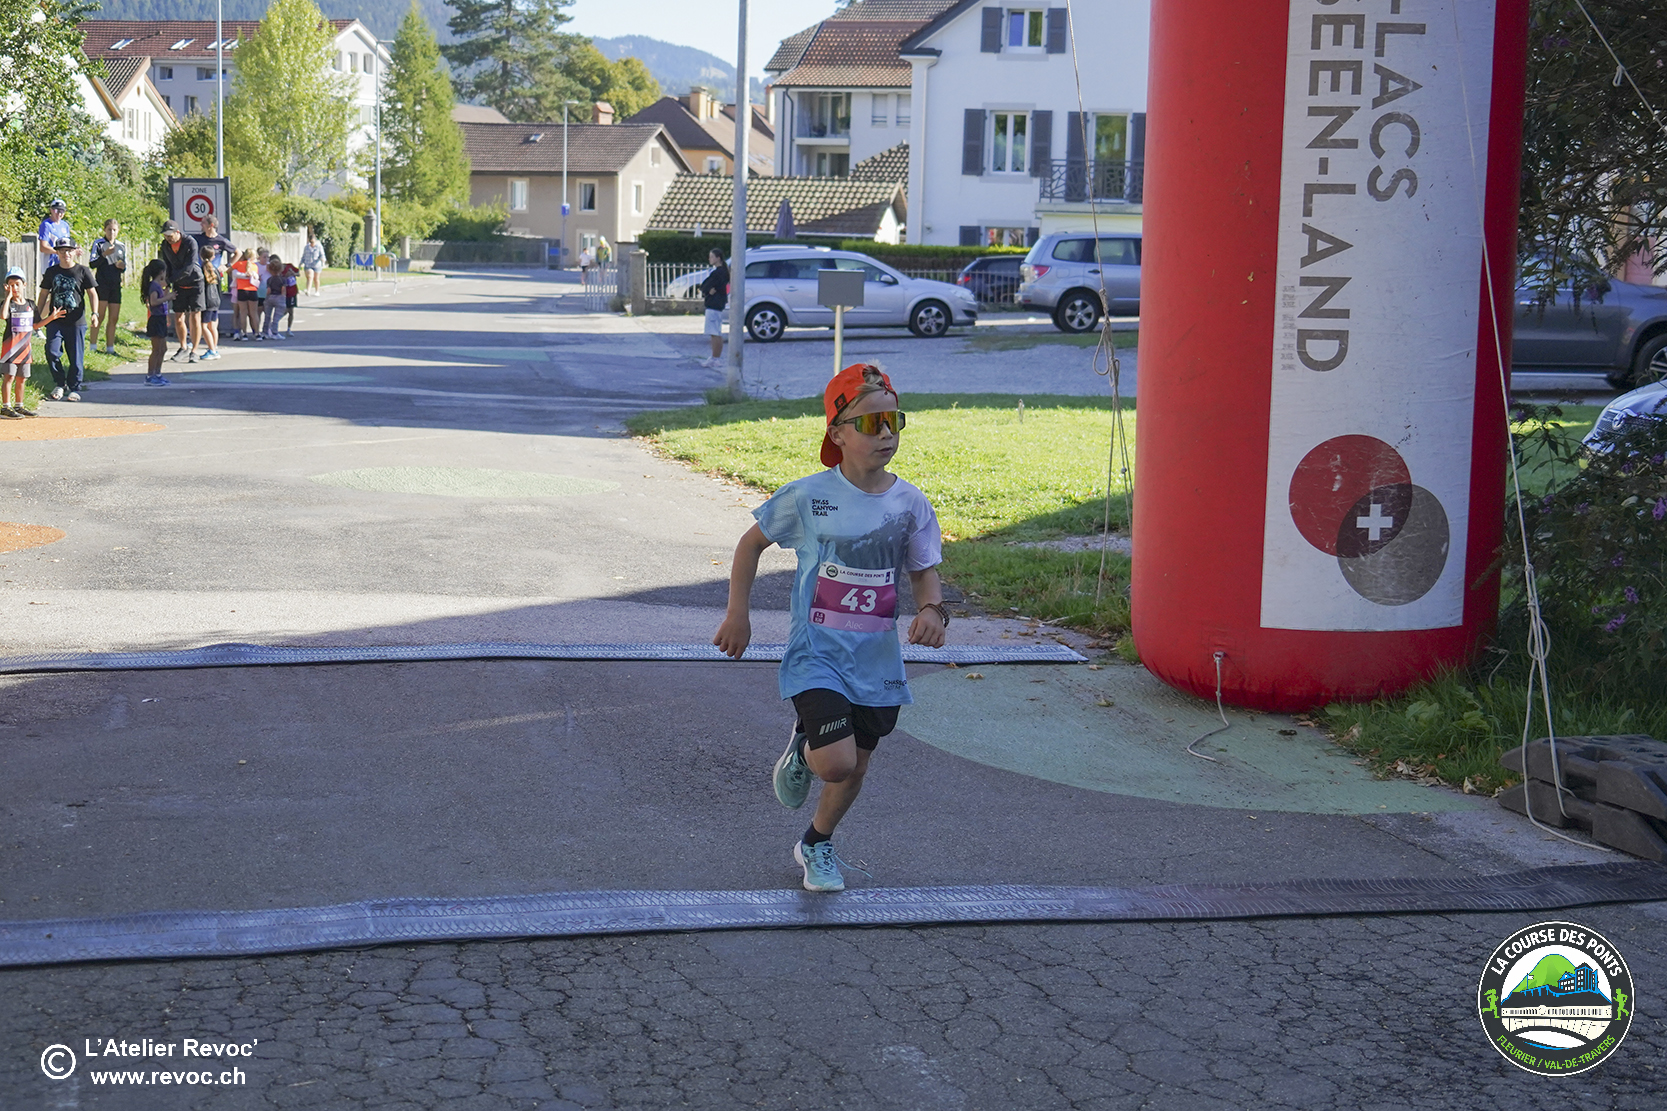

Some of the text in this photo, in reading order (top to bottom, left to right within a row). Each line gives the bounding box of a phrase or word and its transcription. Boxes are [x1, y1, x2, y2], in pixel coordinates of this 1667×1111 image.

[1296, 0, 1366, 372] EEN-LAND
[194, 203, 206, 213] 30
[19, 318, 30, 326] 56
[840, 587, 877, 613] 43
[844, 620, 864, 630] Alec
